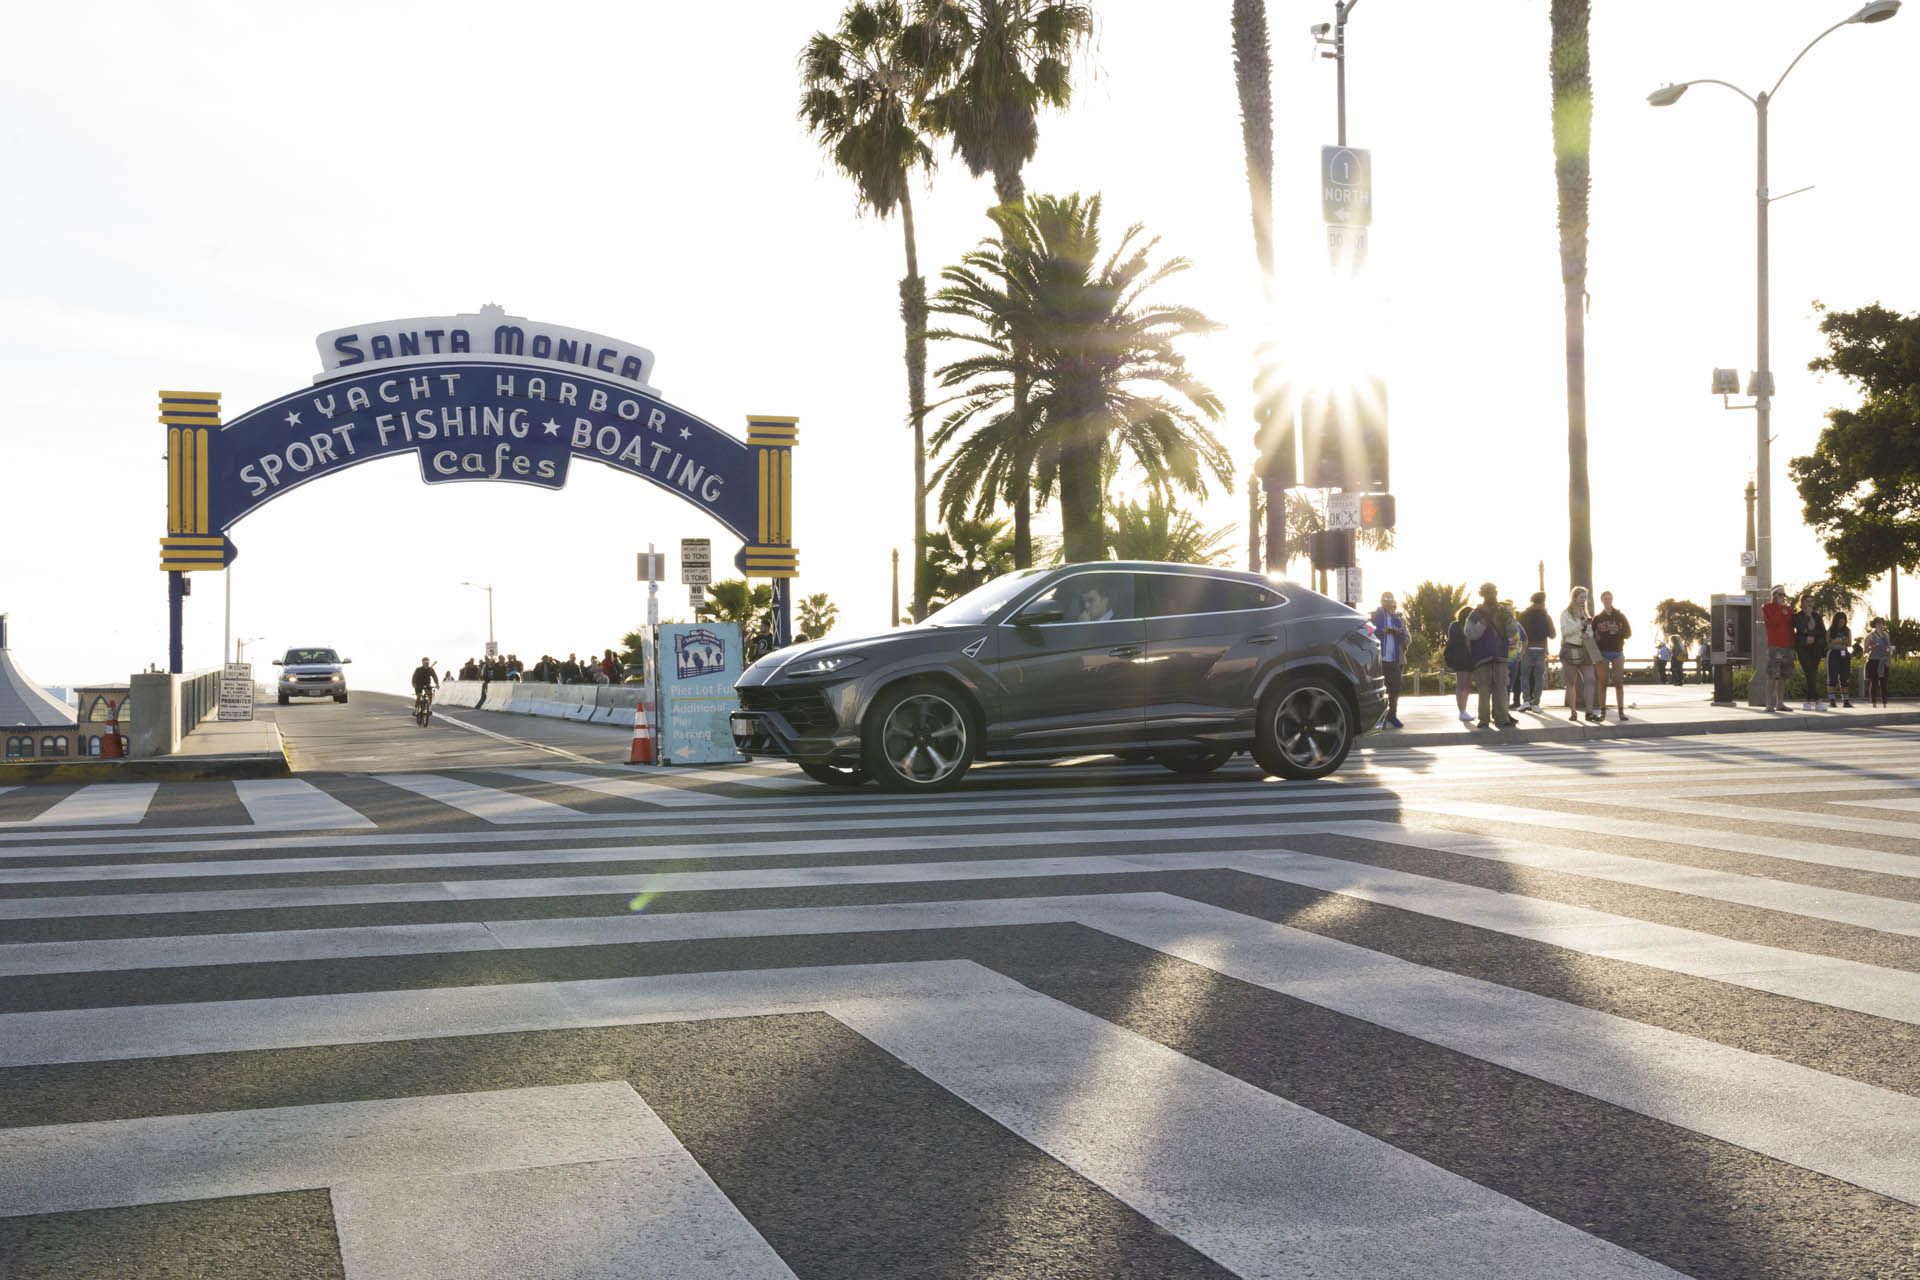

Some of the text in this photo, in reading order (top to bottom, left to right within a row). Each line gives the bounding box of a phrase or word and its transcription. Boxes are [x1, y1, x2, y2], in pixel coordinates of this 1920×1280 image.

[1343, 162, 1349, 179] 1
[1324, 188, 1369, 205] NORTH
[334, 324, 642, 381] SANTA MONICA
[313, 373, 666, 433] YACHT HARBOR
[239, 406, 725, 503] SPORT FISHING BOATING
[695, 684, 713, 696] Lot
[672, 703, 725, 713] Additional
